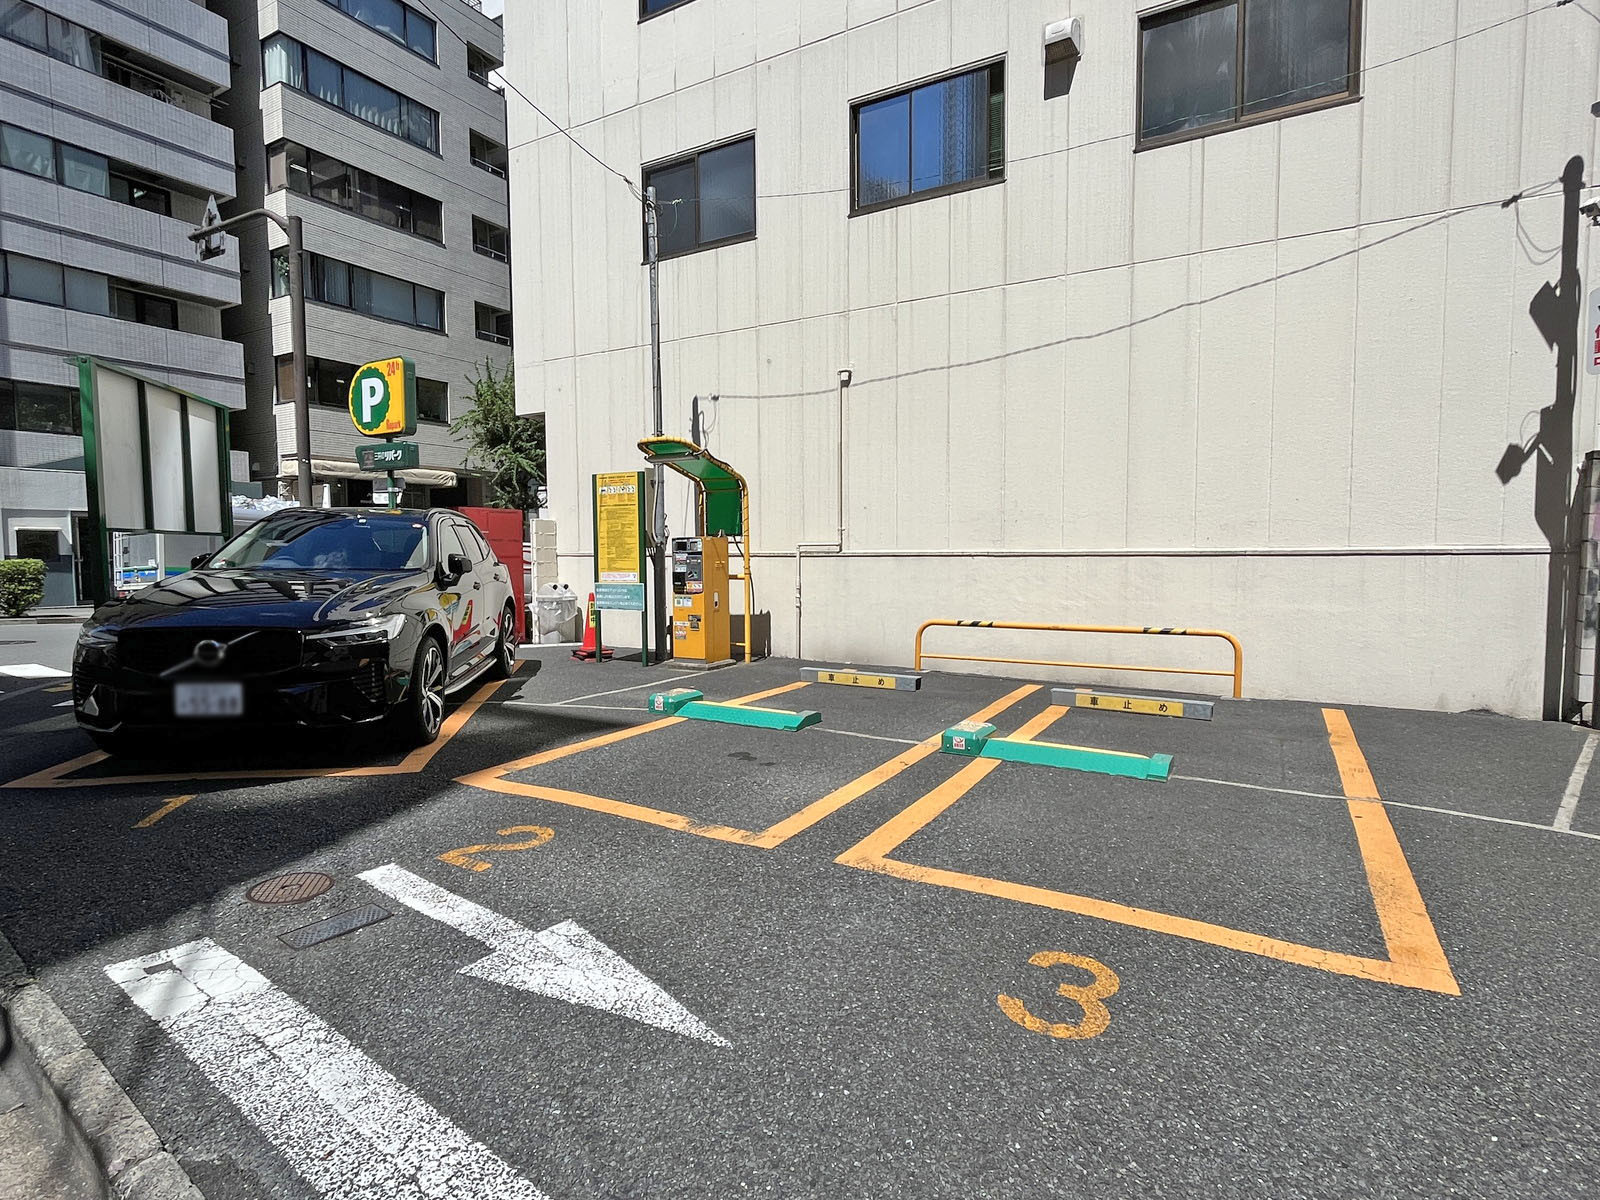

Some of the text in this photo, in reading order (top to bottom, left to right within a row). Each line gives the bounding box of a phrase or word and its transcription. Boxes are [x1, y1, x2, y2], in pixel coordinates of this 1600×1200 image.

[361, 377, 385, 423] P
[828, 673, 885, 686] 車止め
[1090, 696, 1168, 713] 車止め
[436, 825, 555, 873] 2
[997, 951, 1120, 1040] 3
